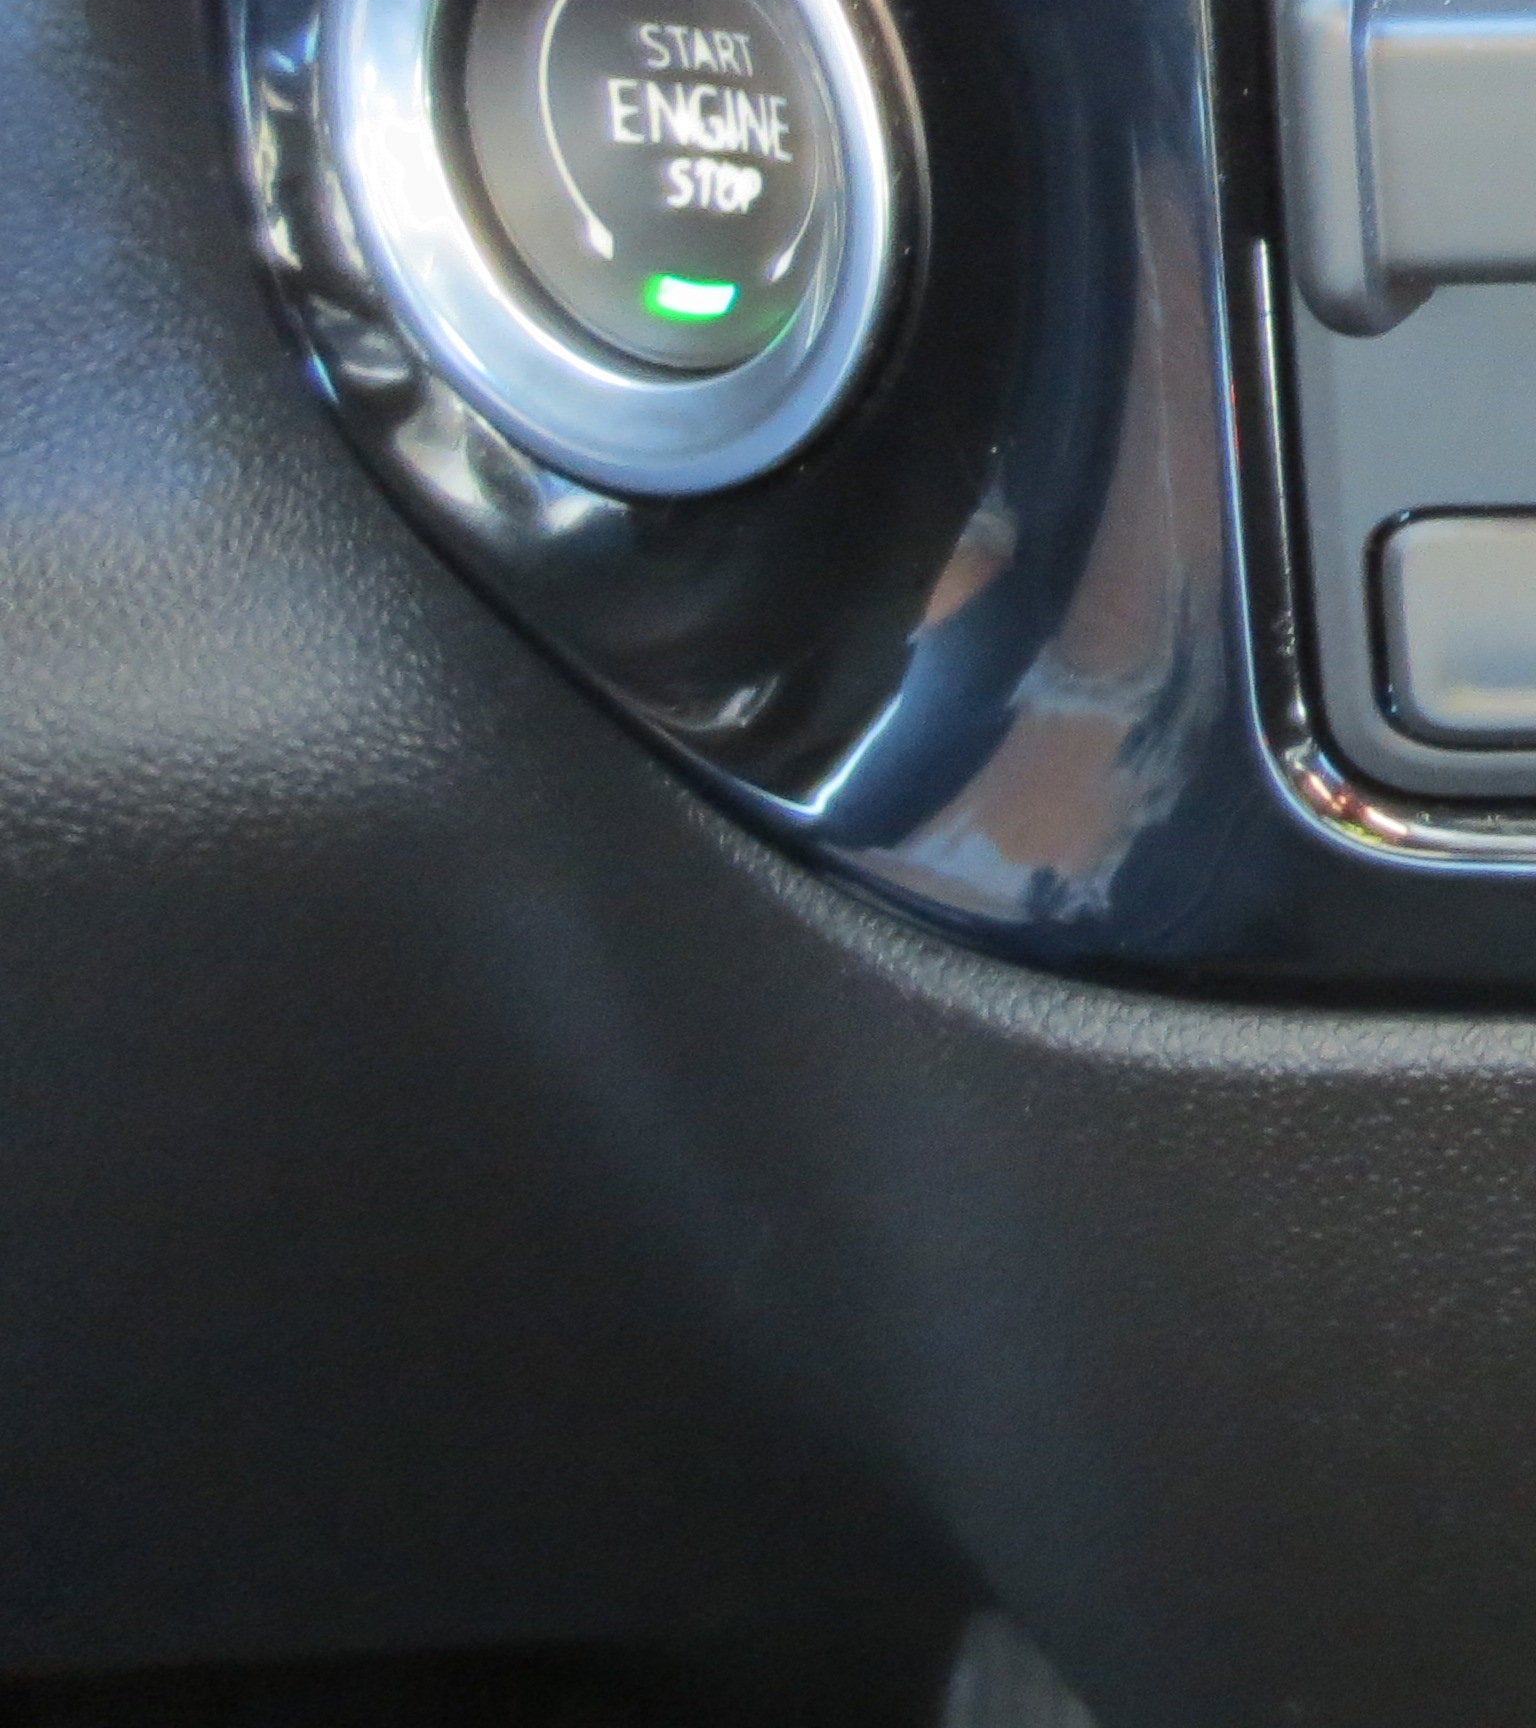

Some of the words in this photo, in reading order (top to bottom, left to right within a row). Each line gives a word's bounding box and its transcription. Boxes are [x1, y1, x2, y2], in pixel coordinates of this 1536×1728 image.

[638, 22, 754, 77] START
[607, 77, 793, 162] ENGINE
[665, 157, 763, 215] STOP
